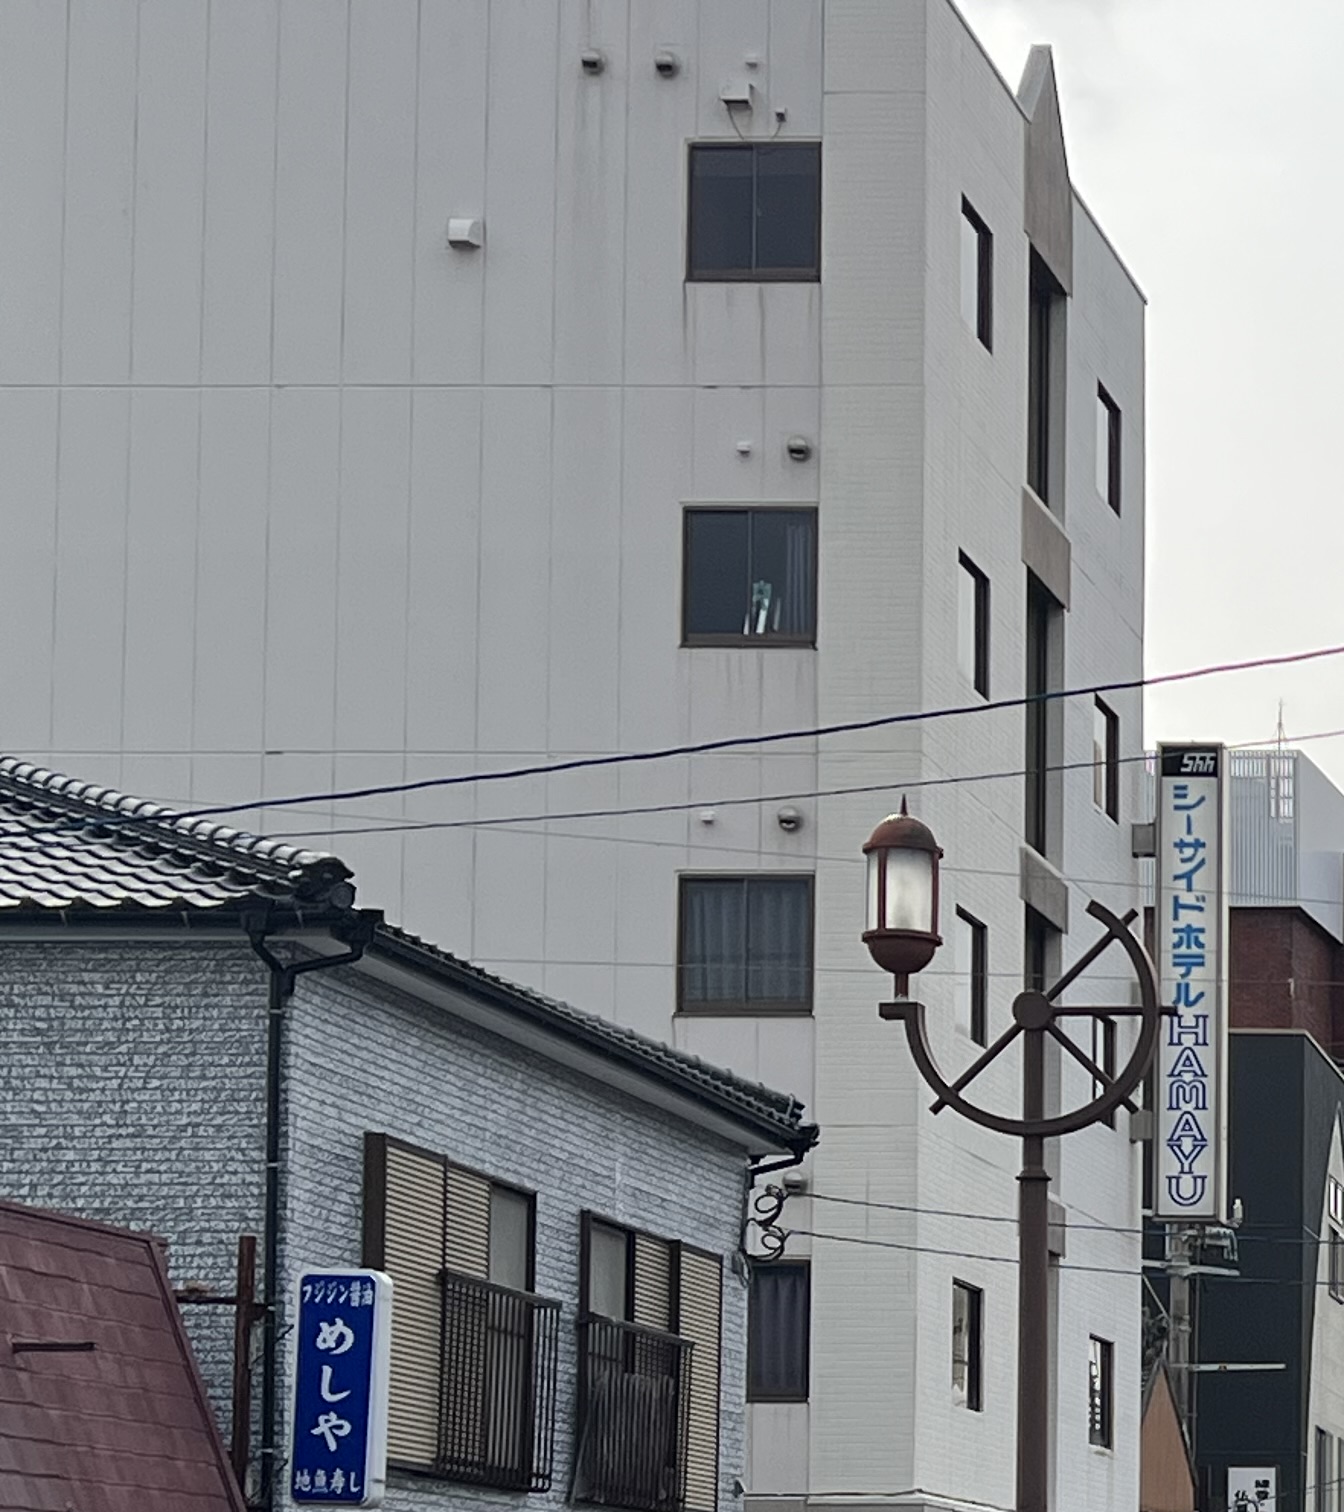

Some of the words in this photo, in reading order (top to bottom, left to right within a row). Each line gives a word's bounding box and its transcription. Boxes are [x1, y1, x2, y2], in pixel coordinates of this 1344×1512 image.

[1171, 784, 1206, 1008] シーサイドホテル
[1166, 1013, 1209, 1207] HAMAYU
[302, 1280, 374, 1307] フジジン醤油
[310, 1317, 355, 1452] めしや
[293, 1467, 362, 1495] 地魚寿し
